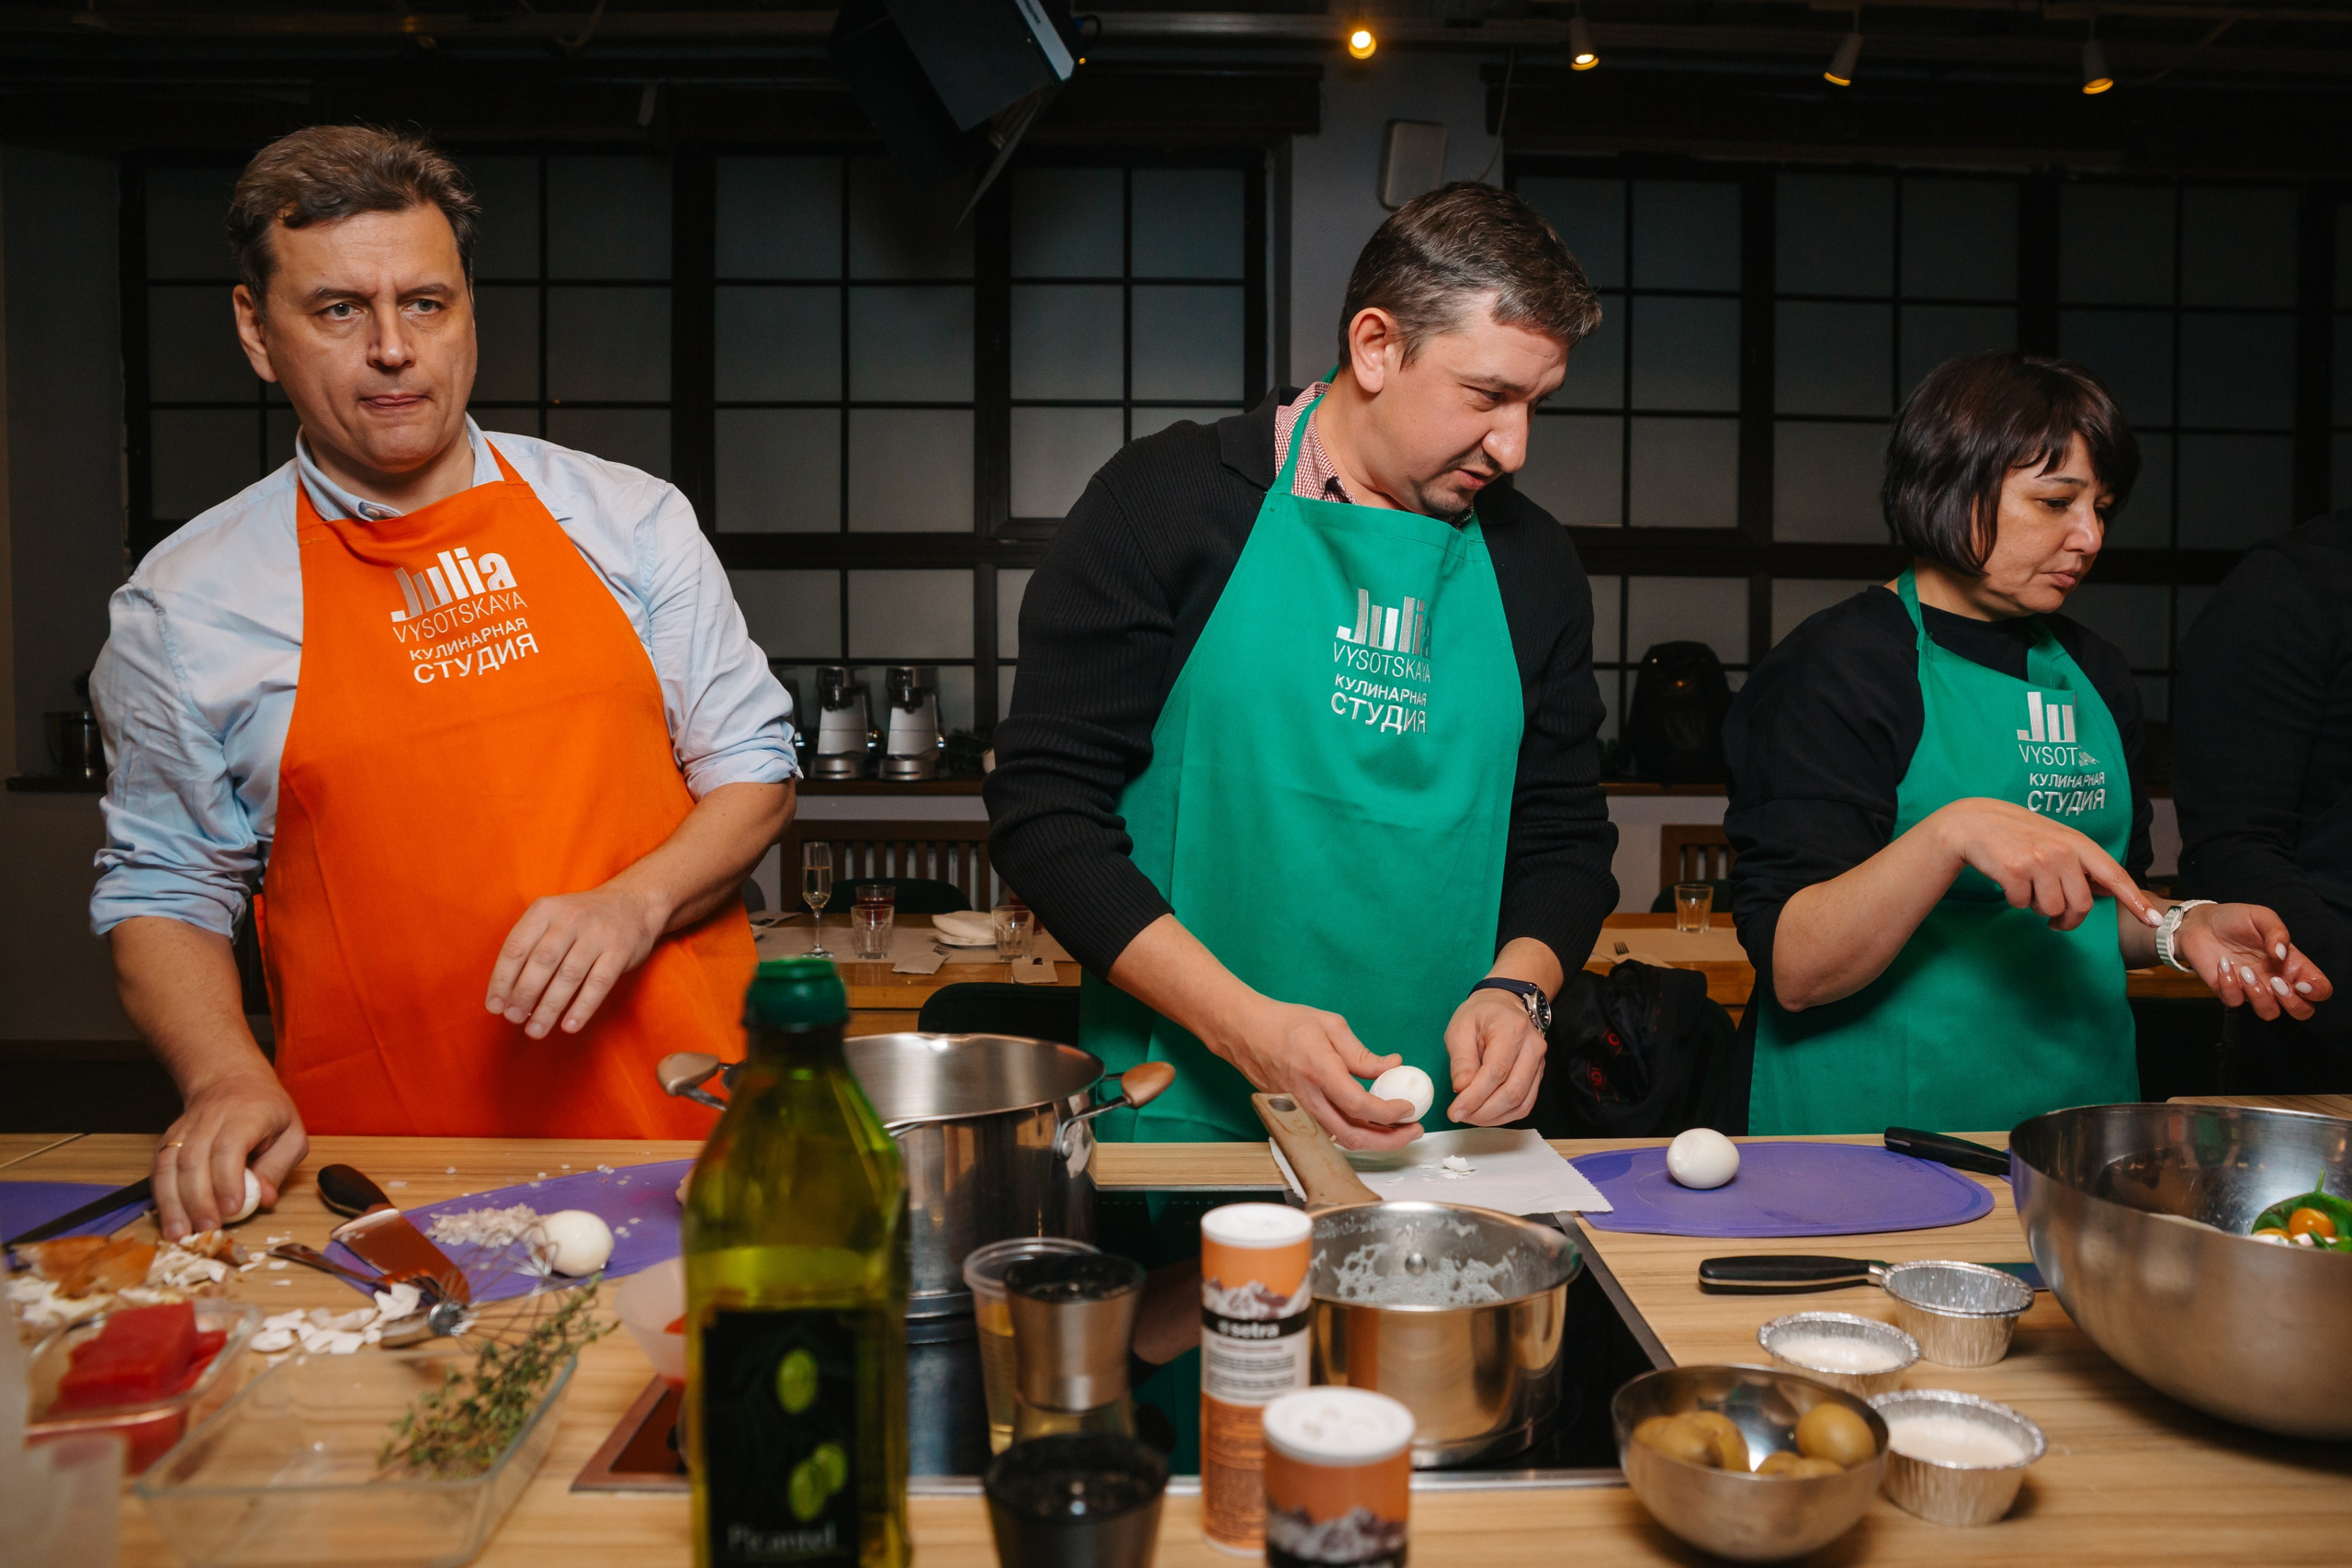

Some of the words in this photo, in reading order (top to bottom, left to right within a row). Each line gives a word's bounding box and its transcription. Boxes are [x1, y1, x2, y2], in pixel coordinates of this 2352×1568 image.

[390, 547, 517, 623] Julia
[393, 592, 528, 643] VYSOTSKAYA
[410, 617, 529, 660] КУЛИНАРНАЯ
[413, 633, 539, 683] СТУДИЯ
[1335, 673, 1427, 706] КУЛИНАРНАЯ
[1331, 692, 1427, 735] СТУДИЯ
[2027, 788, 2106, 816] СТУДИЯ
